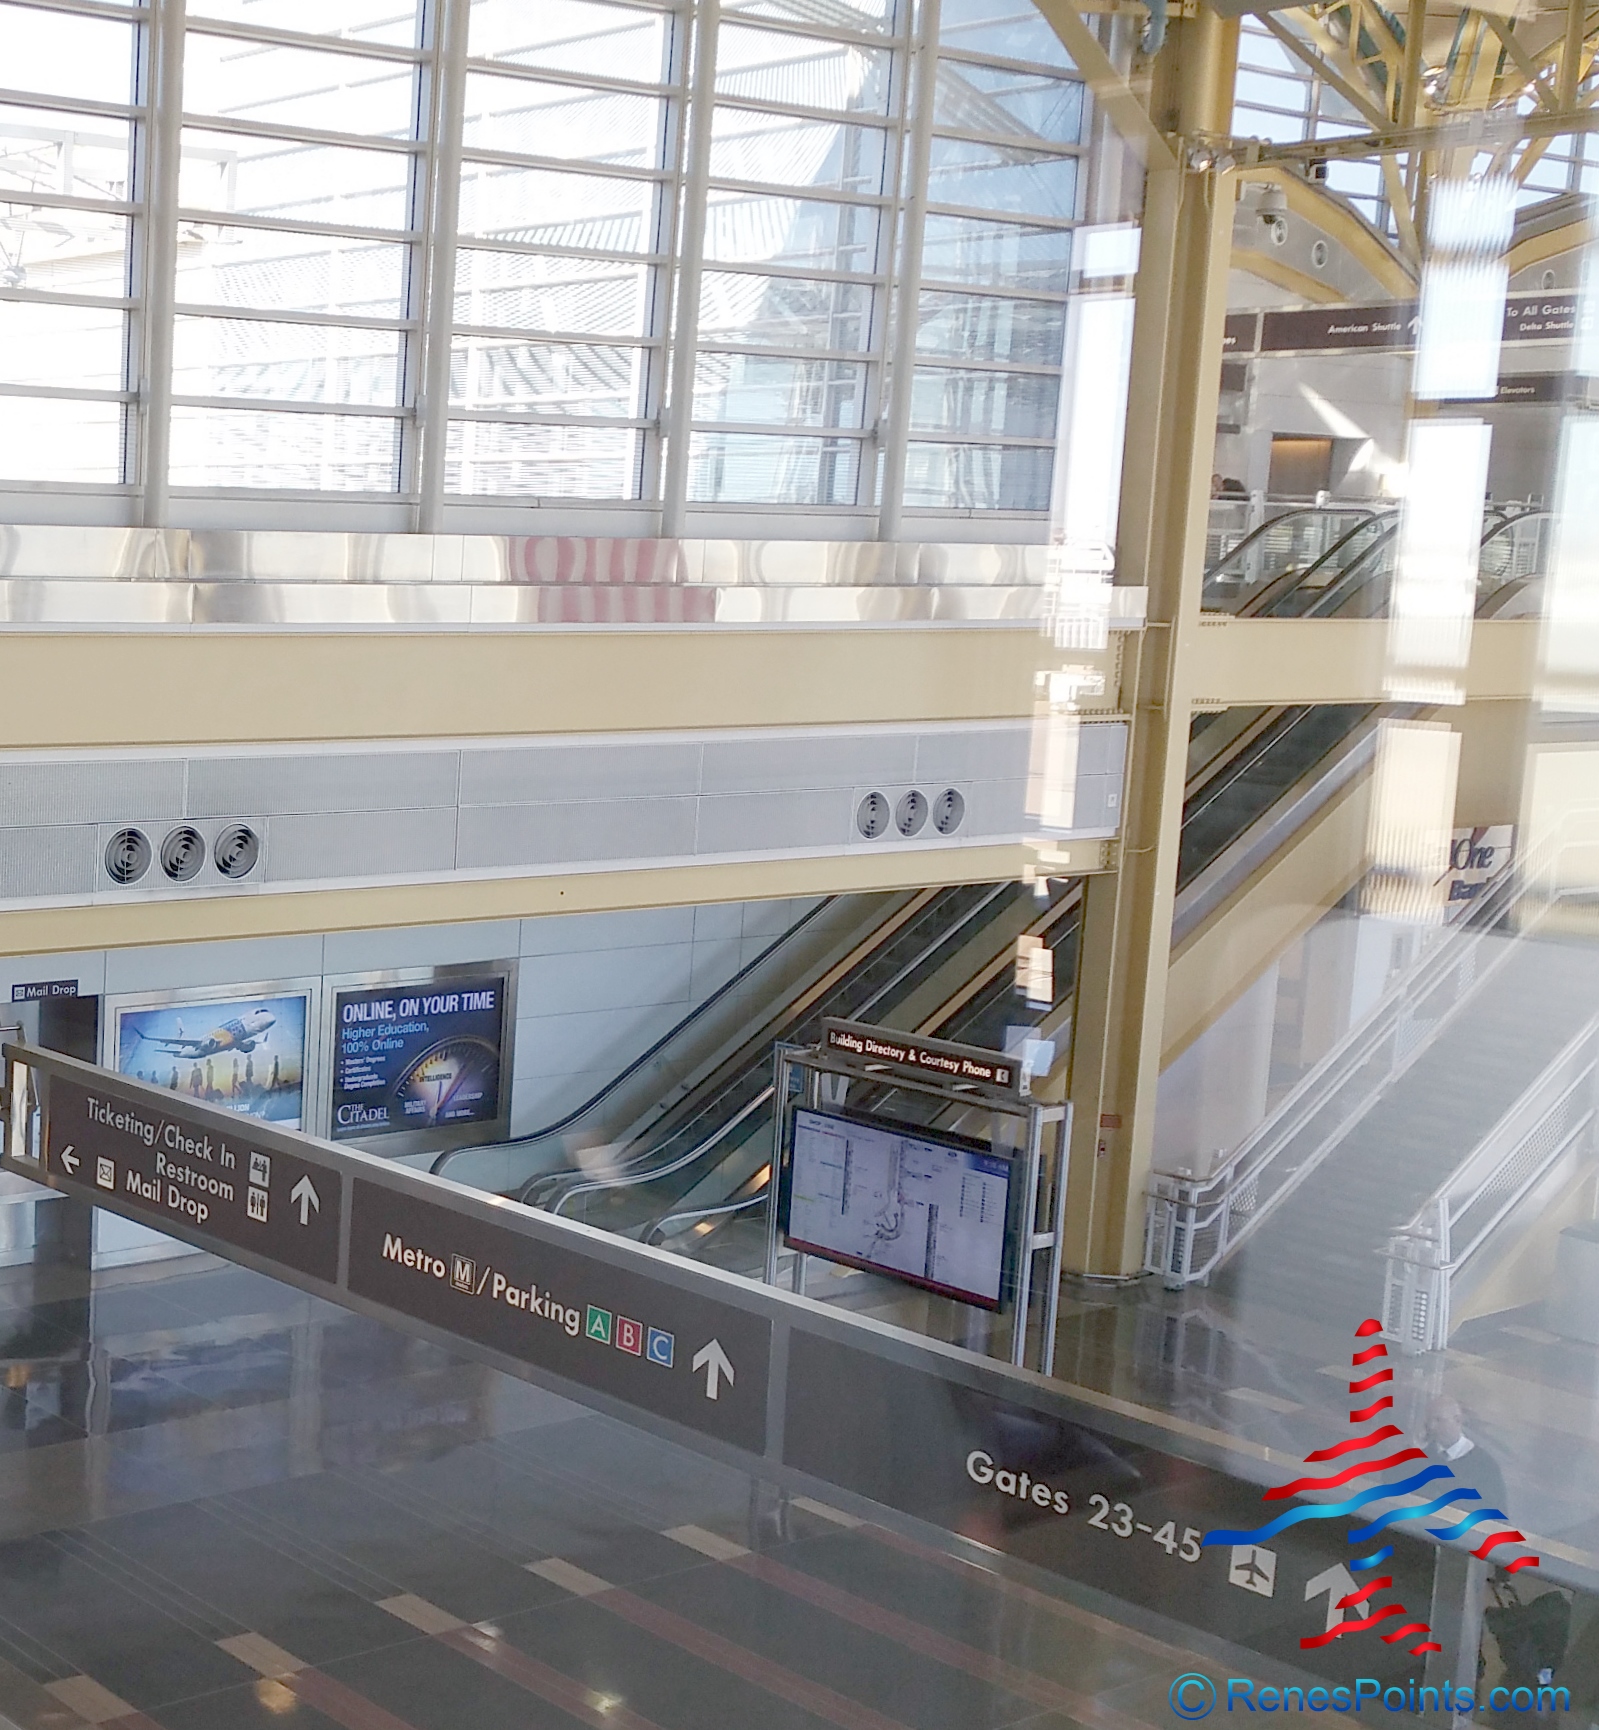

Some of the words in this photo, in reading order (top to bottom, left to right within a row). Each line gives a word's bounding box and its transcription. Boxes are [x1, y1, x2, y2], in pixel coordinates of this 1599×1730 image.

[1506, 307, 1518, 317] To
[1522, 305, 1538, 316] All
[1542, 304, 1576, 315] Gates
[1327, 323, 1368, 334] American
[1372, 322, 1401, 332] Shuttle
[1519, 322, 1542, 332] Delta
[1545, 320, 1575, 330] Shuttle
[1500, 386, 1535, 395] Elevators
[26, 985, 49, 998] Mail
[52, 984, 76, 999] Drop
[342, 1000, 397, 1023] ONLINE,
[400, 997, 419, 1018] ON
[419, 994, 459, 1016] YOUR
[461, 990, 495, 1011] TIME
[342, 1025, 376, 1042] Higher
[377, 1020, 429, 1037] Education,
[341, 1039, 370, 1054] 100%
[371, 1037, 404, 1051] Online
[829, 1032, 863, 1053] Building
[865, 1038, 906, 1062] Directory
[908, 1049, 916, 1062] &
[919, 1052, 960, 1074] Courtesy
[962, 1060, 992, 1078] Phone
[337, 1104, 390, 1124] CITADEL
[351, 1103, 365, 1111] THE
[87, 1097, 213, 1162] Ticketing/Check
[220, 1143, 236, 1170] In
[155, 1152, 234, 1201] Restroom
[126, 1169, 162, 1202] Mail
[168, 1184, 209, 1224] Drop
[382, 1232, 446, 1279] Metro
[590, 1313, 607, 1339] A
[653, 1335, 669, 1361] C
[966, 1450, 1070, 1514] Gates
[1087, 1493, 1202, 1563] 23-45
